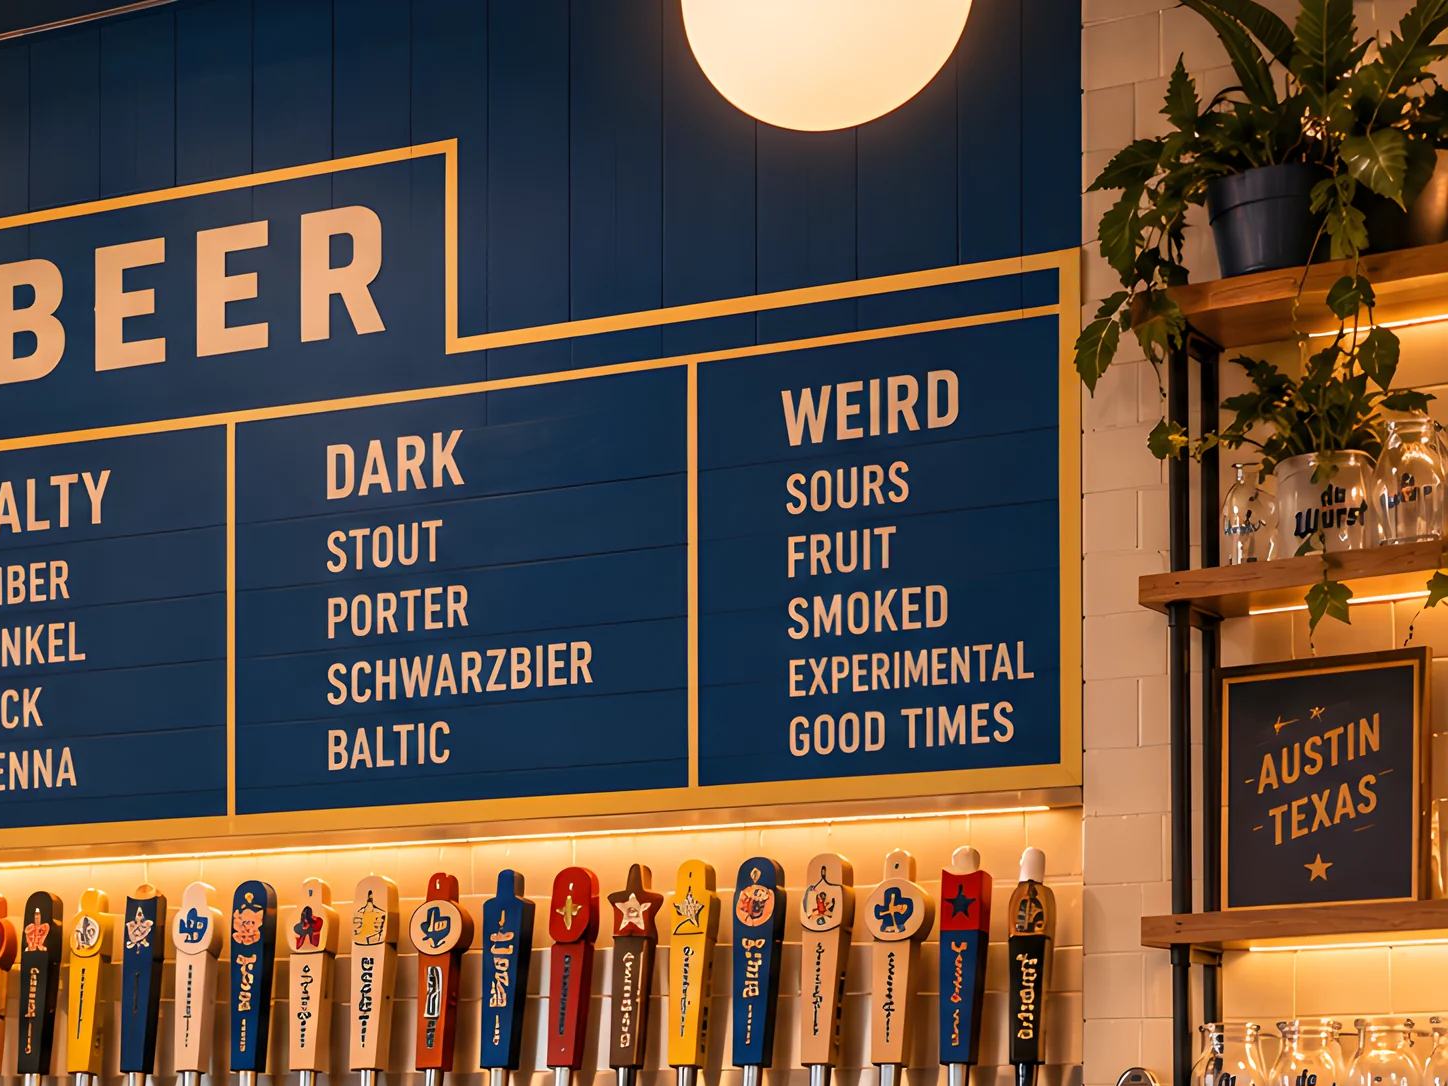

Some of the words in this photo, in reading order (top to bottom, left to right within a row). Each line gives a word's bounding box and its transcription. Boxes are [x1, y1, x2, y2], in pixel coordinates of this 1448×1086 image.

[782, 370, 958, 446] WEIRD
[327, 430, 464, 499] DARK
[787, 461, 908, 514] SOURS
[327, 520, 442, 572] STOUT
[788, 526, 896, 577] FRUIT
[328, 585, 468, 639] PORTER
[788, 585, 947, 639] SMOKED
[328, 641, 592, 705] SCHWARZBIER
[790, 641, 1034, 697] EXPERIMENTAL
[328, 721, 450, 770] BALTIC
[790, 711, 885, 756] GOOD
[901, 702, 1014, 748] TIMES
[1257, 712, 1380, 794] AUSTIN
[1269, 774, 1377, 846] TEXAS
